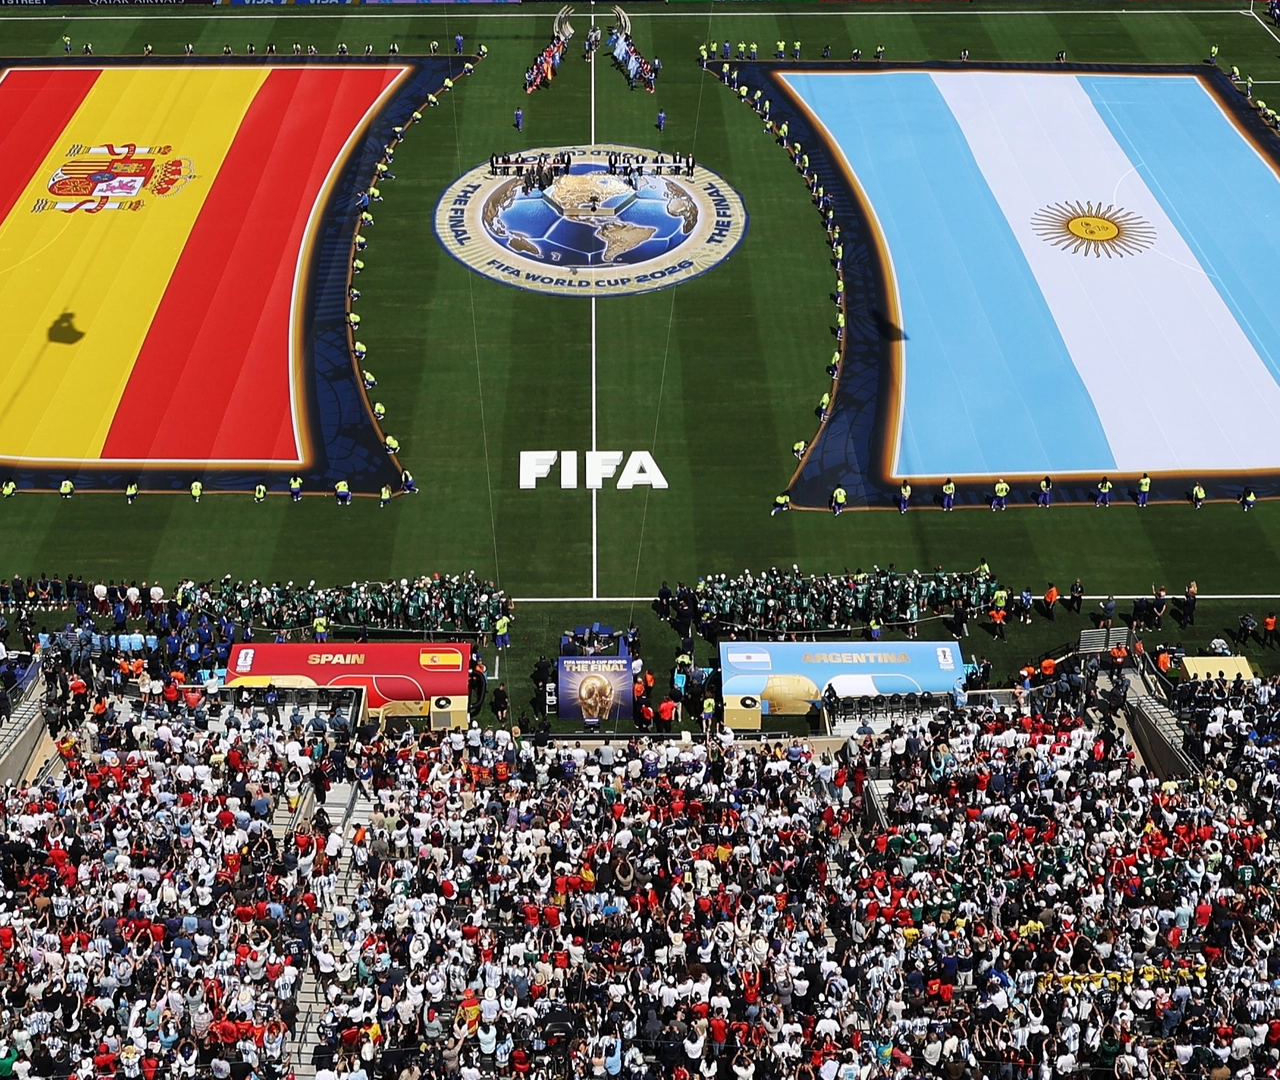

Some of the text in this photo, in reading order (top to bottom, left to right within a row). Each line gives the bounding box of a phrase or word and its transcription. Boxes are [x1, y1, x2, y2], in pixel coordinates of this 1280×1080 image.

[449, 183, 481, 246] THE FINAL
[703, 182, 731, 245] THE FINAL
[486, 259, 694, 288] FIFA WORLD CUP 2026
[519, 450, 669, 489] FIFA
[307, 653, 365, 665] SPAIN
[590, 664, 627, 672] FINAL
[802, 653, 910, 664] ARGENTINA
